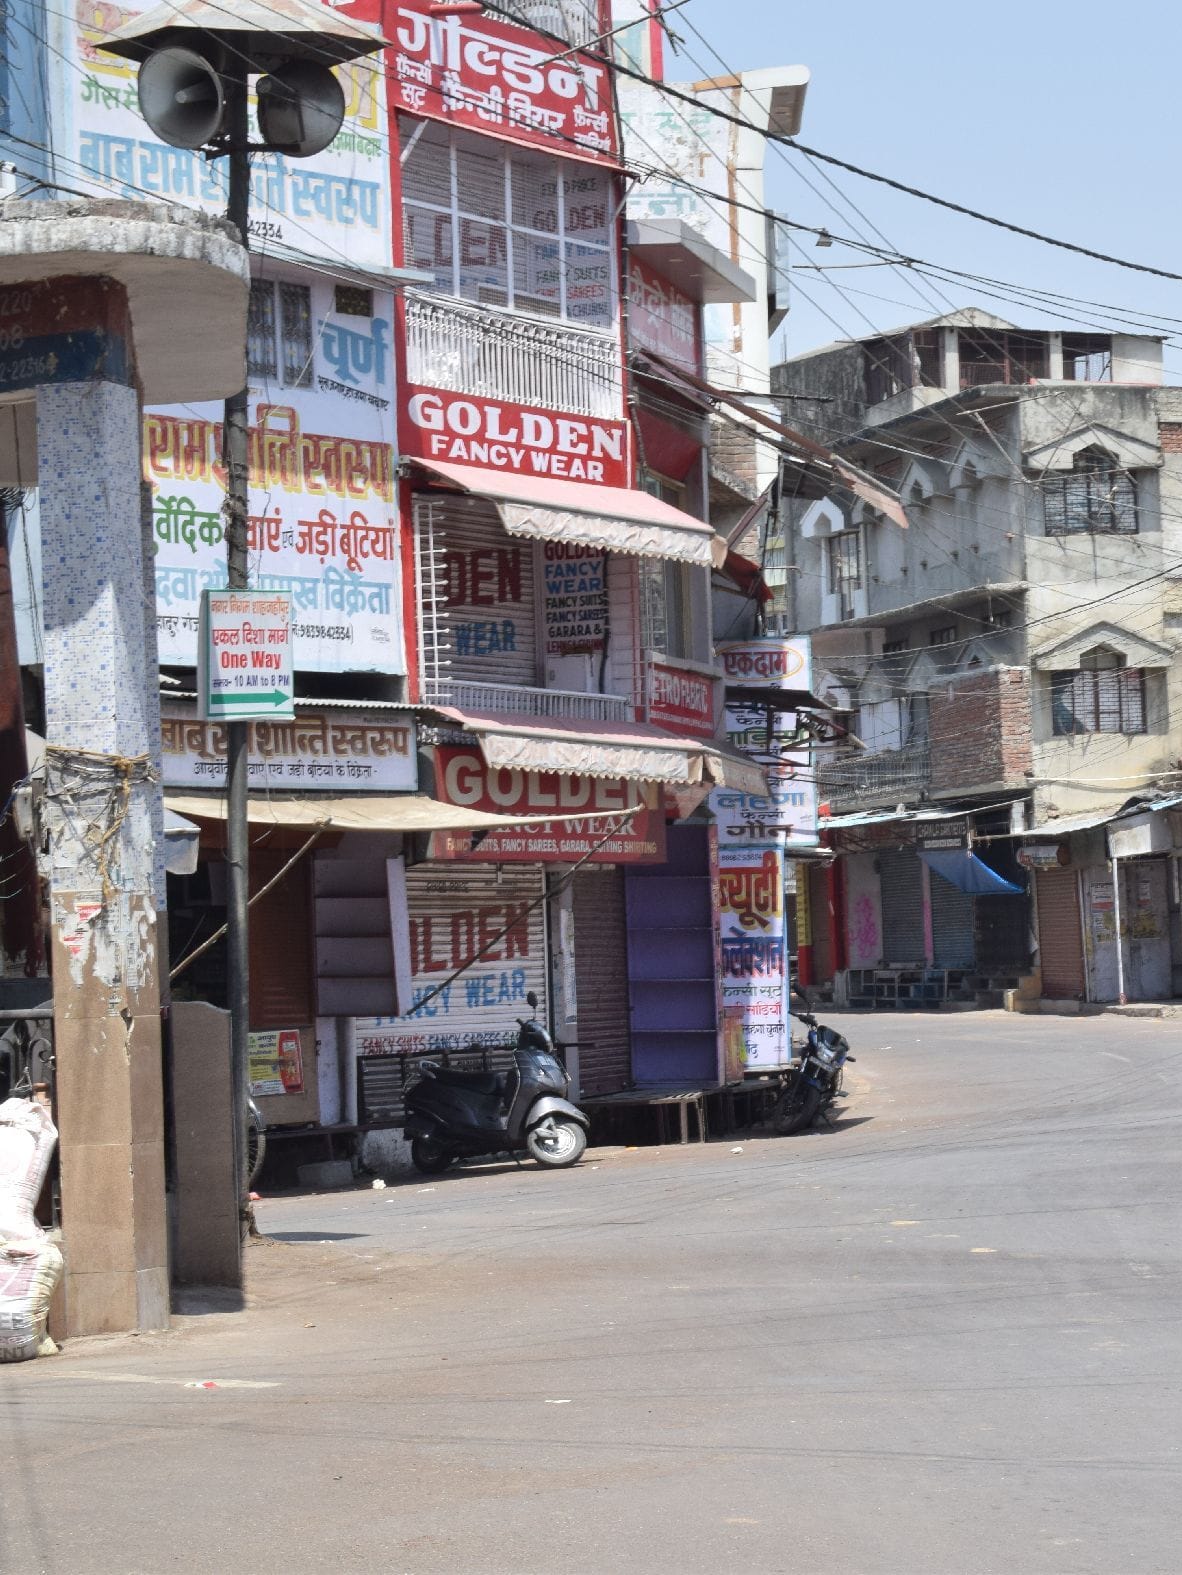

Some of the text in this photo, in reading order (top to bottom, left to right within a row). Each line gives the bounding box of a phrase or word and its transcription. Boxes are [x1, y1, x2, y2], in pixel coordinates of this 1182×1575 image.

[533, 204, 607, 234] GODEN
[408, 393, 623, 461] GOLDEN
[431, 435, 604, 482] FANCY WEAR
[545, 561, 602, 579] FANCY
[545, 577, 602, 595] WEAR
[454, 619, 518, 655] WEAR
[221, 650, 282, 670] One Way
[445, 755, 658, 808] GOLDEN
[562, 811, 637, 836] WEAR
[465, 967, 528, 1009] WEAR
